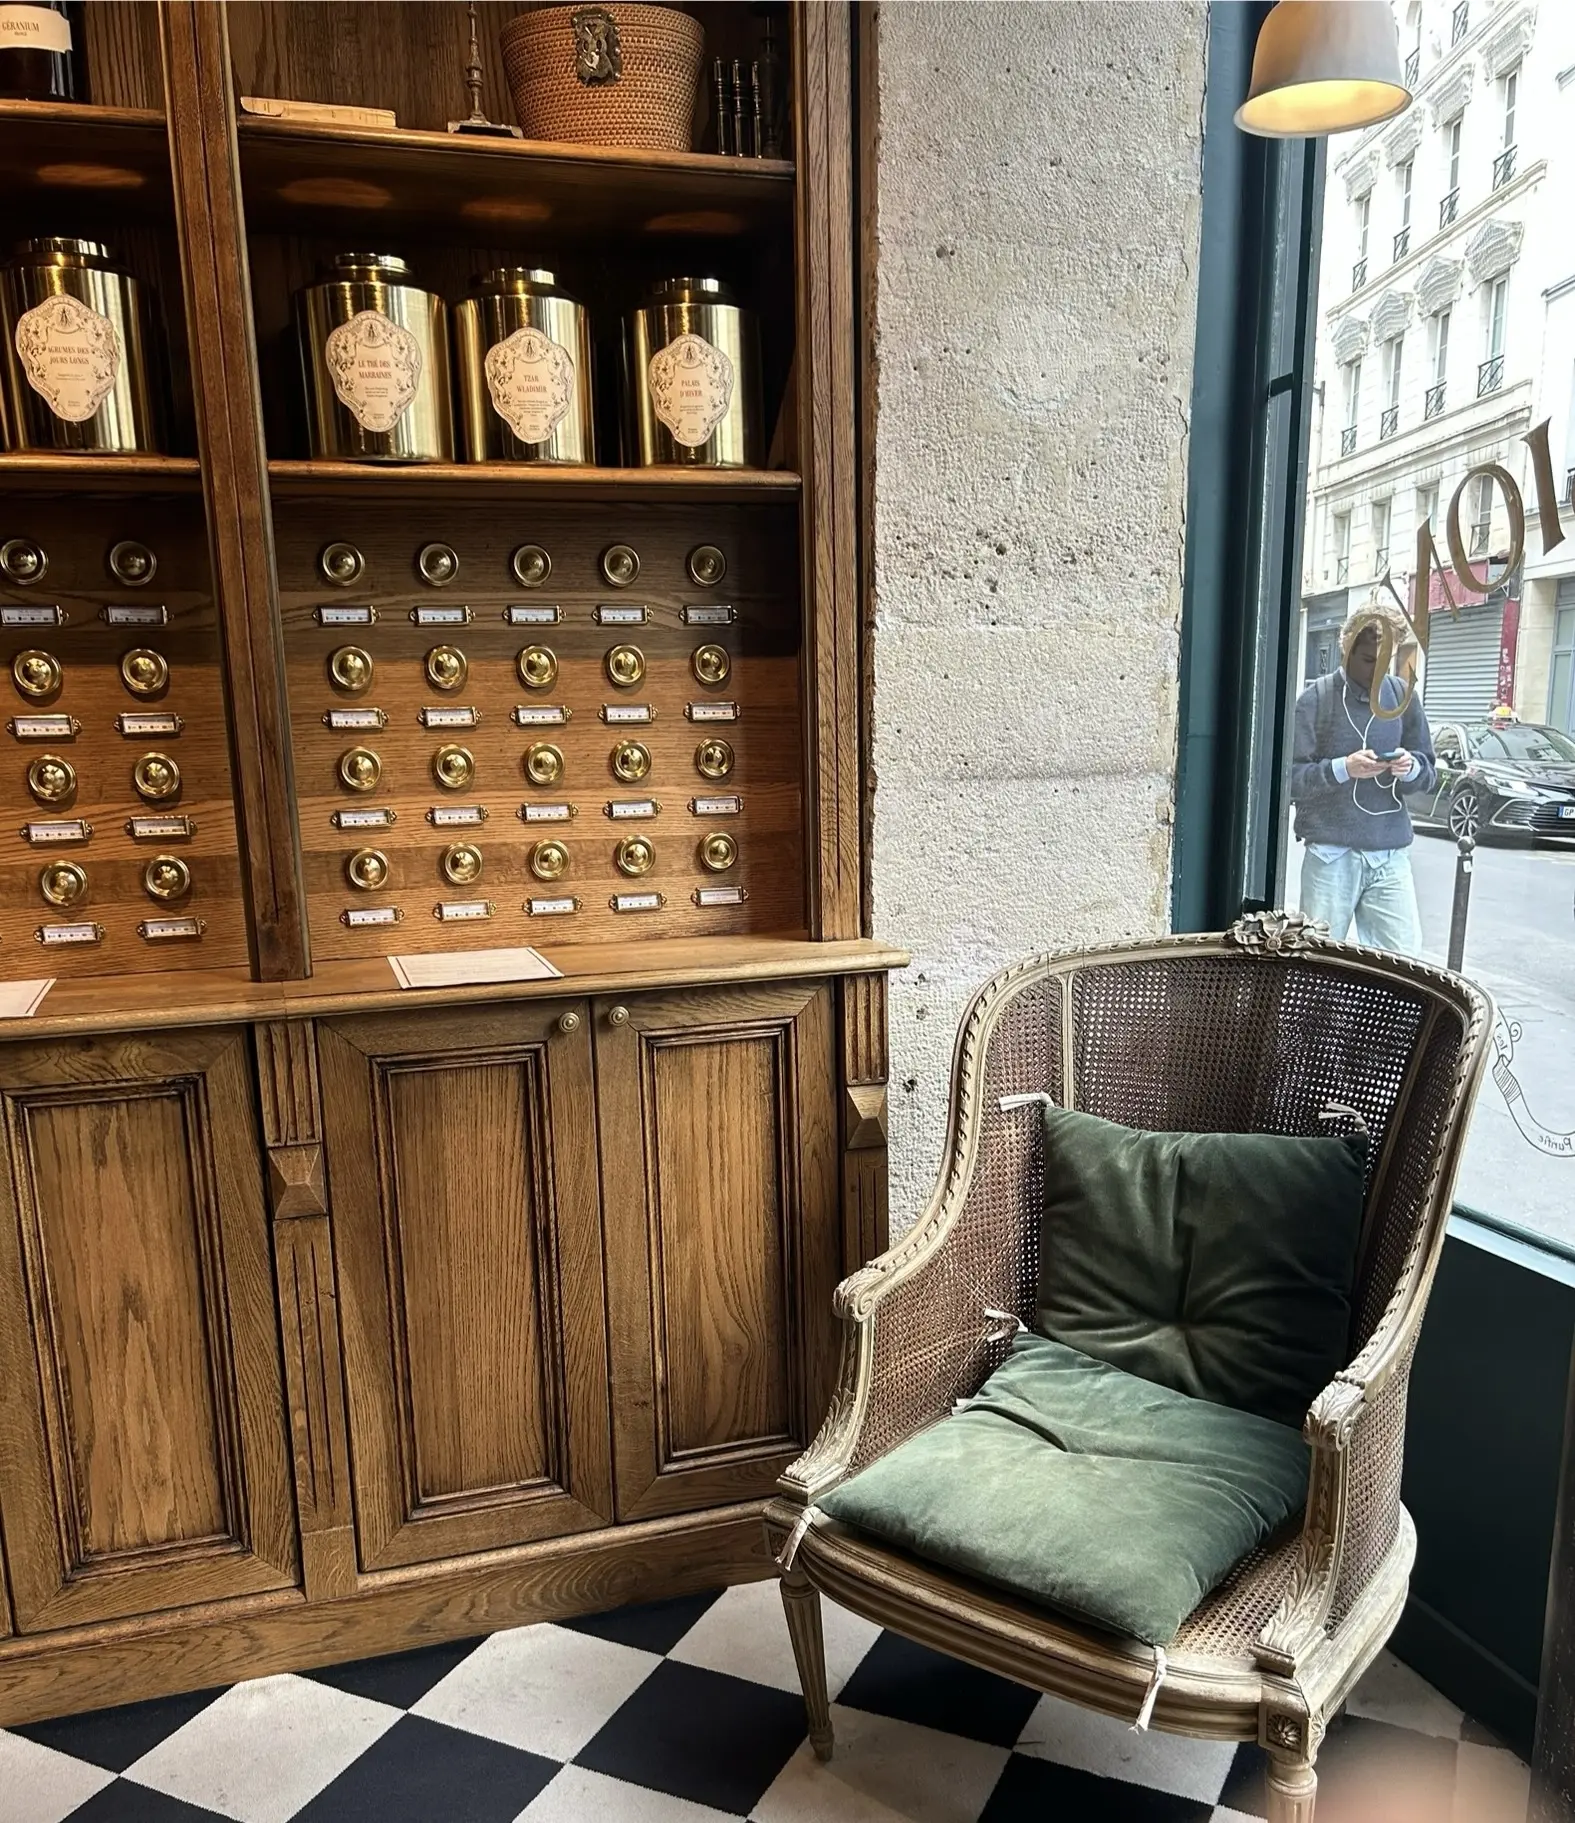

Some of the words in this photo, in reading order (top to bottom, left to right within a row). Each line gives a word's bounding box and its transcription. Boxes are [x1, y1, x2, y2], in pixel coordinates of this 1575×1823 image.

[2, 19, 40, 32] GÉRANIUM
[48, 345, 76, 354] AGRUMES
[50, 357, 69, 365] JOURS
[70, 357, 90, 365] LONGS
[358, 360, 365, 368] LE
[367, 359, 379, 368] THÉ
[380, 360, 391, 368] DES
[516, 385, 548, 393] WLADIMIR
